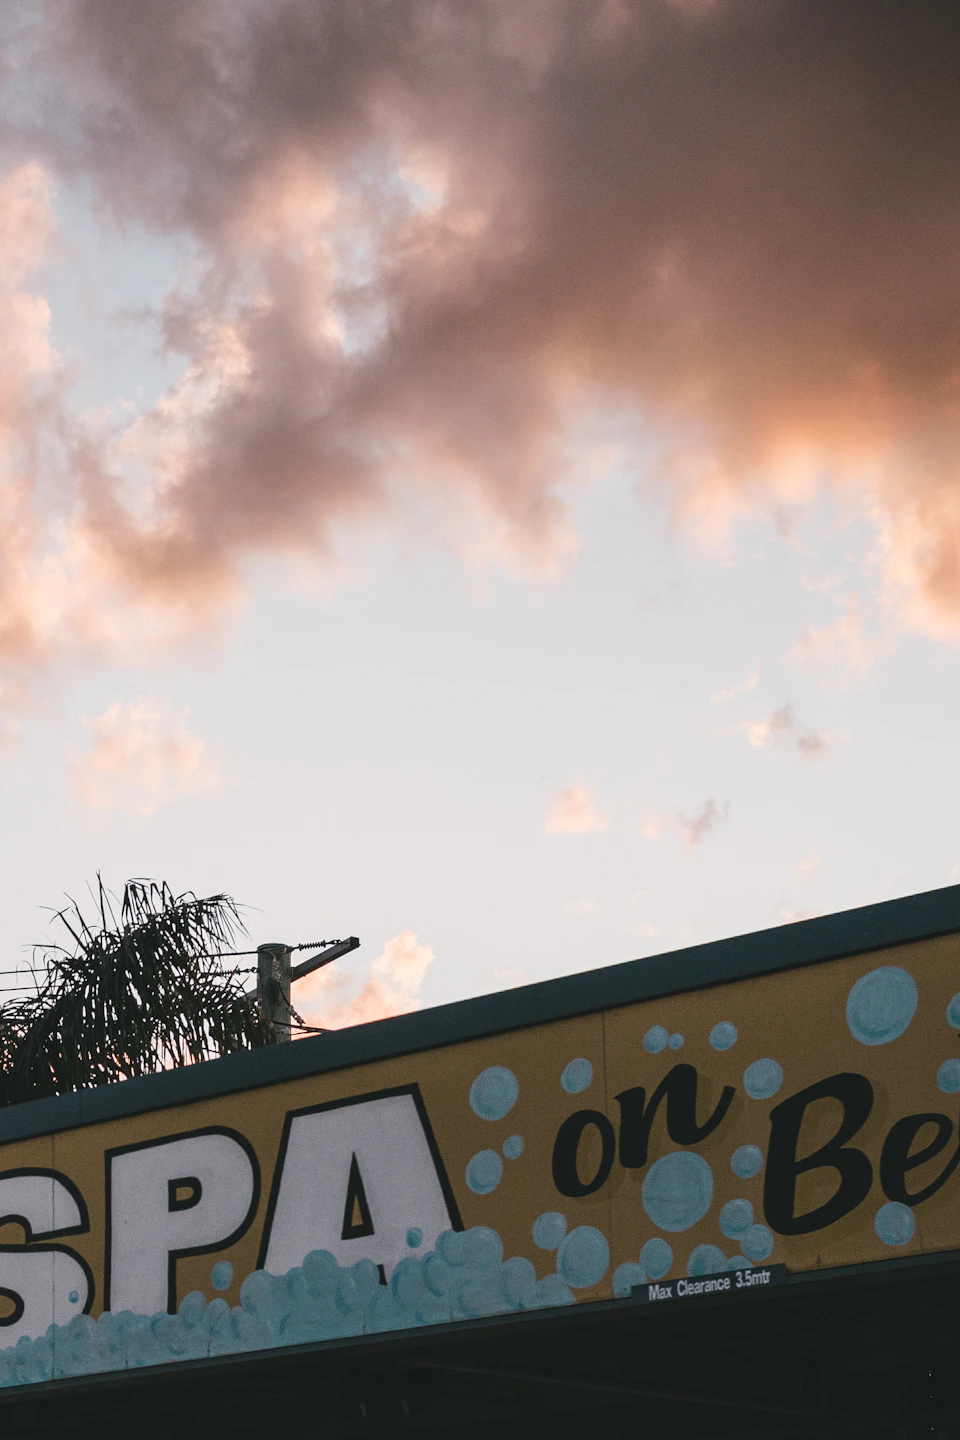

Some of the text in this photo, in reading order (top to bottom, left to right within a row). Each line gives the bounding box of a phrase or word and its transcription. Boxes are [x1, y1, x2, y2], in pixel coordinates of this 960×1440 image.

[552, 1064, 736, 1197] on
[763, 1072, 960, 1235] Be
[648, 1270, 771, 1300] Max Clearance 3.5mtr
